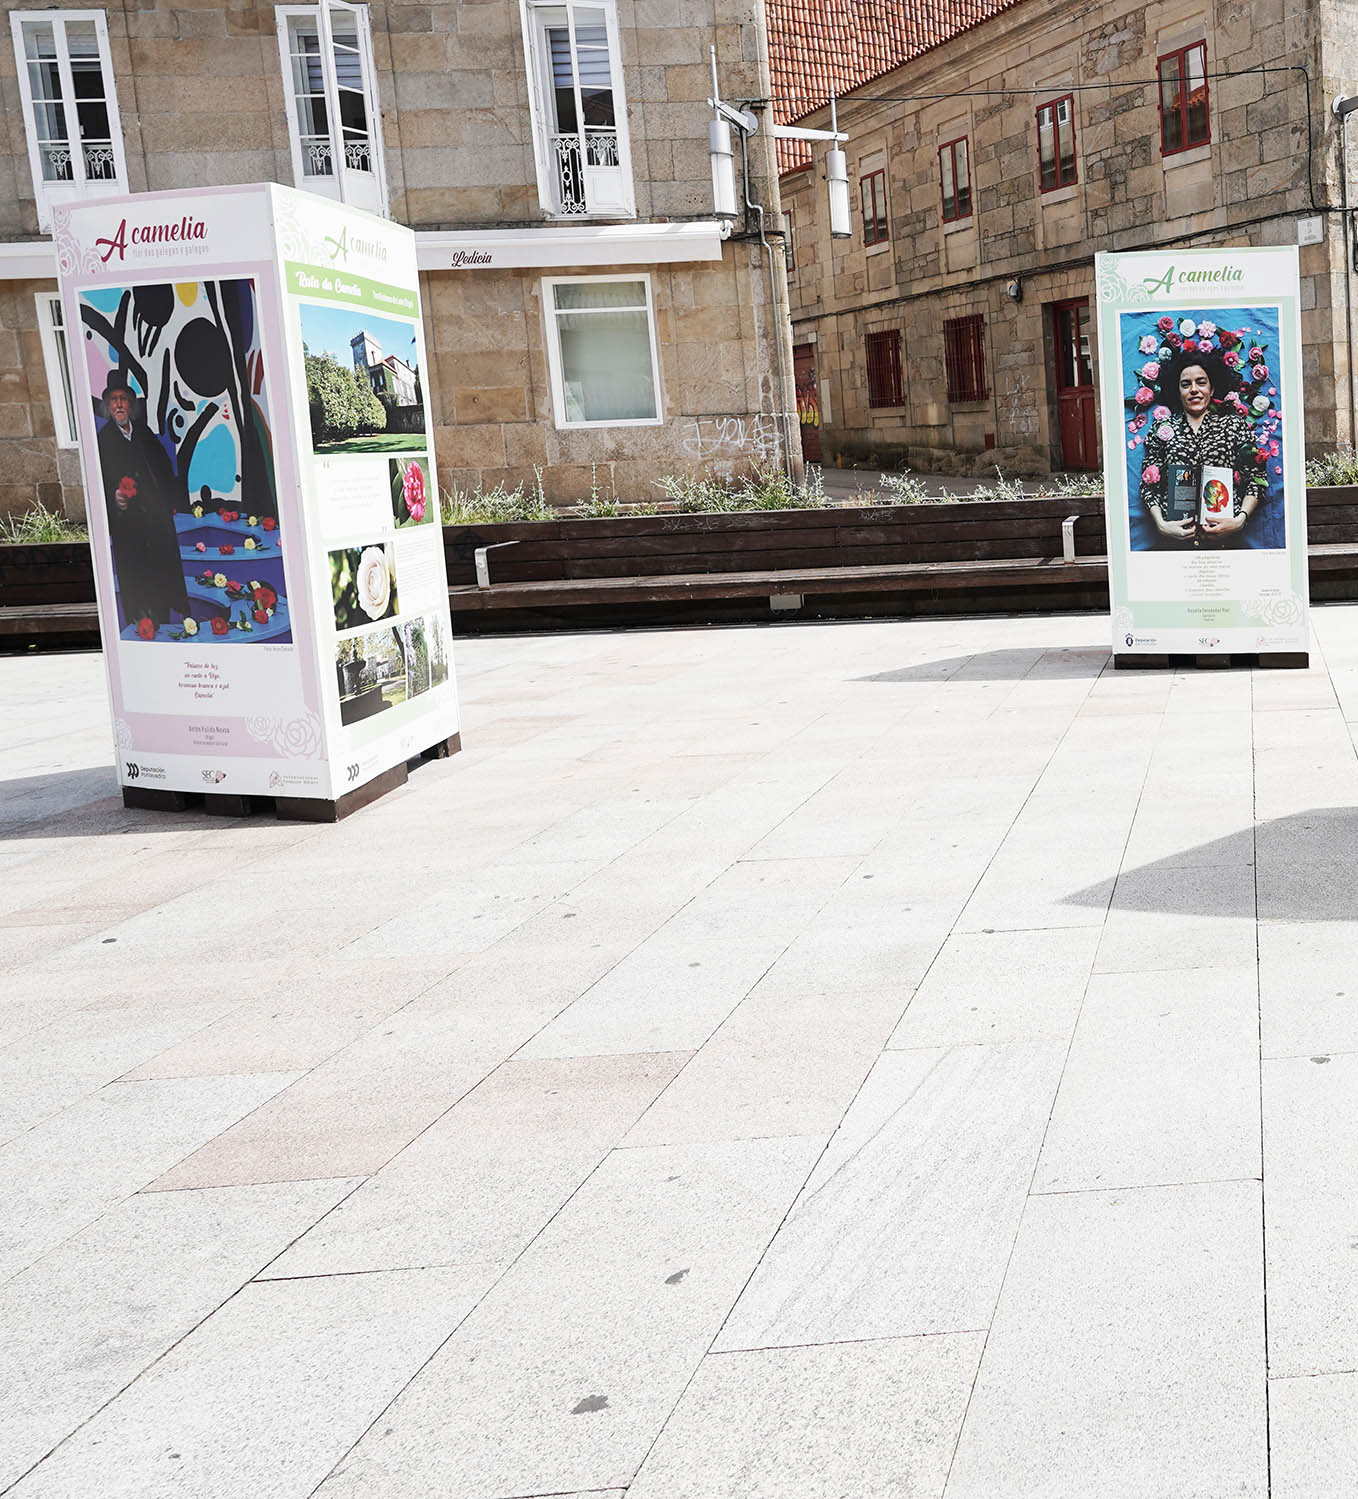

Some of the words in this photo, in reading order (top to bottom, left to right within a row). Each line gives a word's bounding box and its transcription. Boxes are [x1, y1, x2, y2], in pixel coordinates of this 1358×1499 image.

[96, 218, 129, 263] A
[131, 216, 209, 245] camelia
[451, 250, 493, 268] Ledicia
[1143, 265, 1176, 295] A
[1178, 264, 1245, 283] camelia
